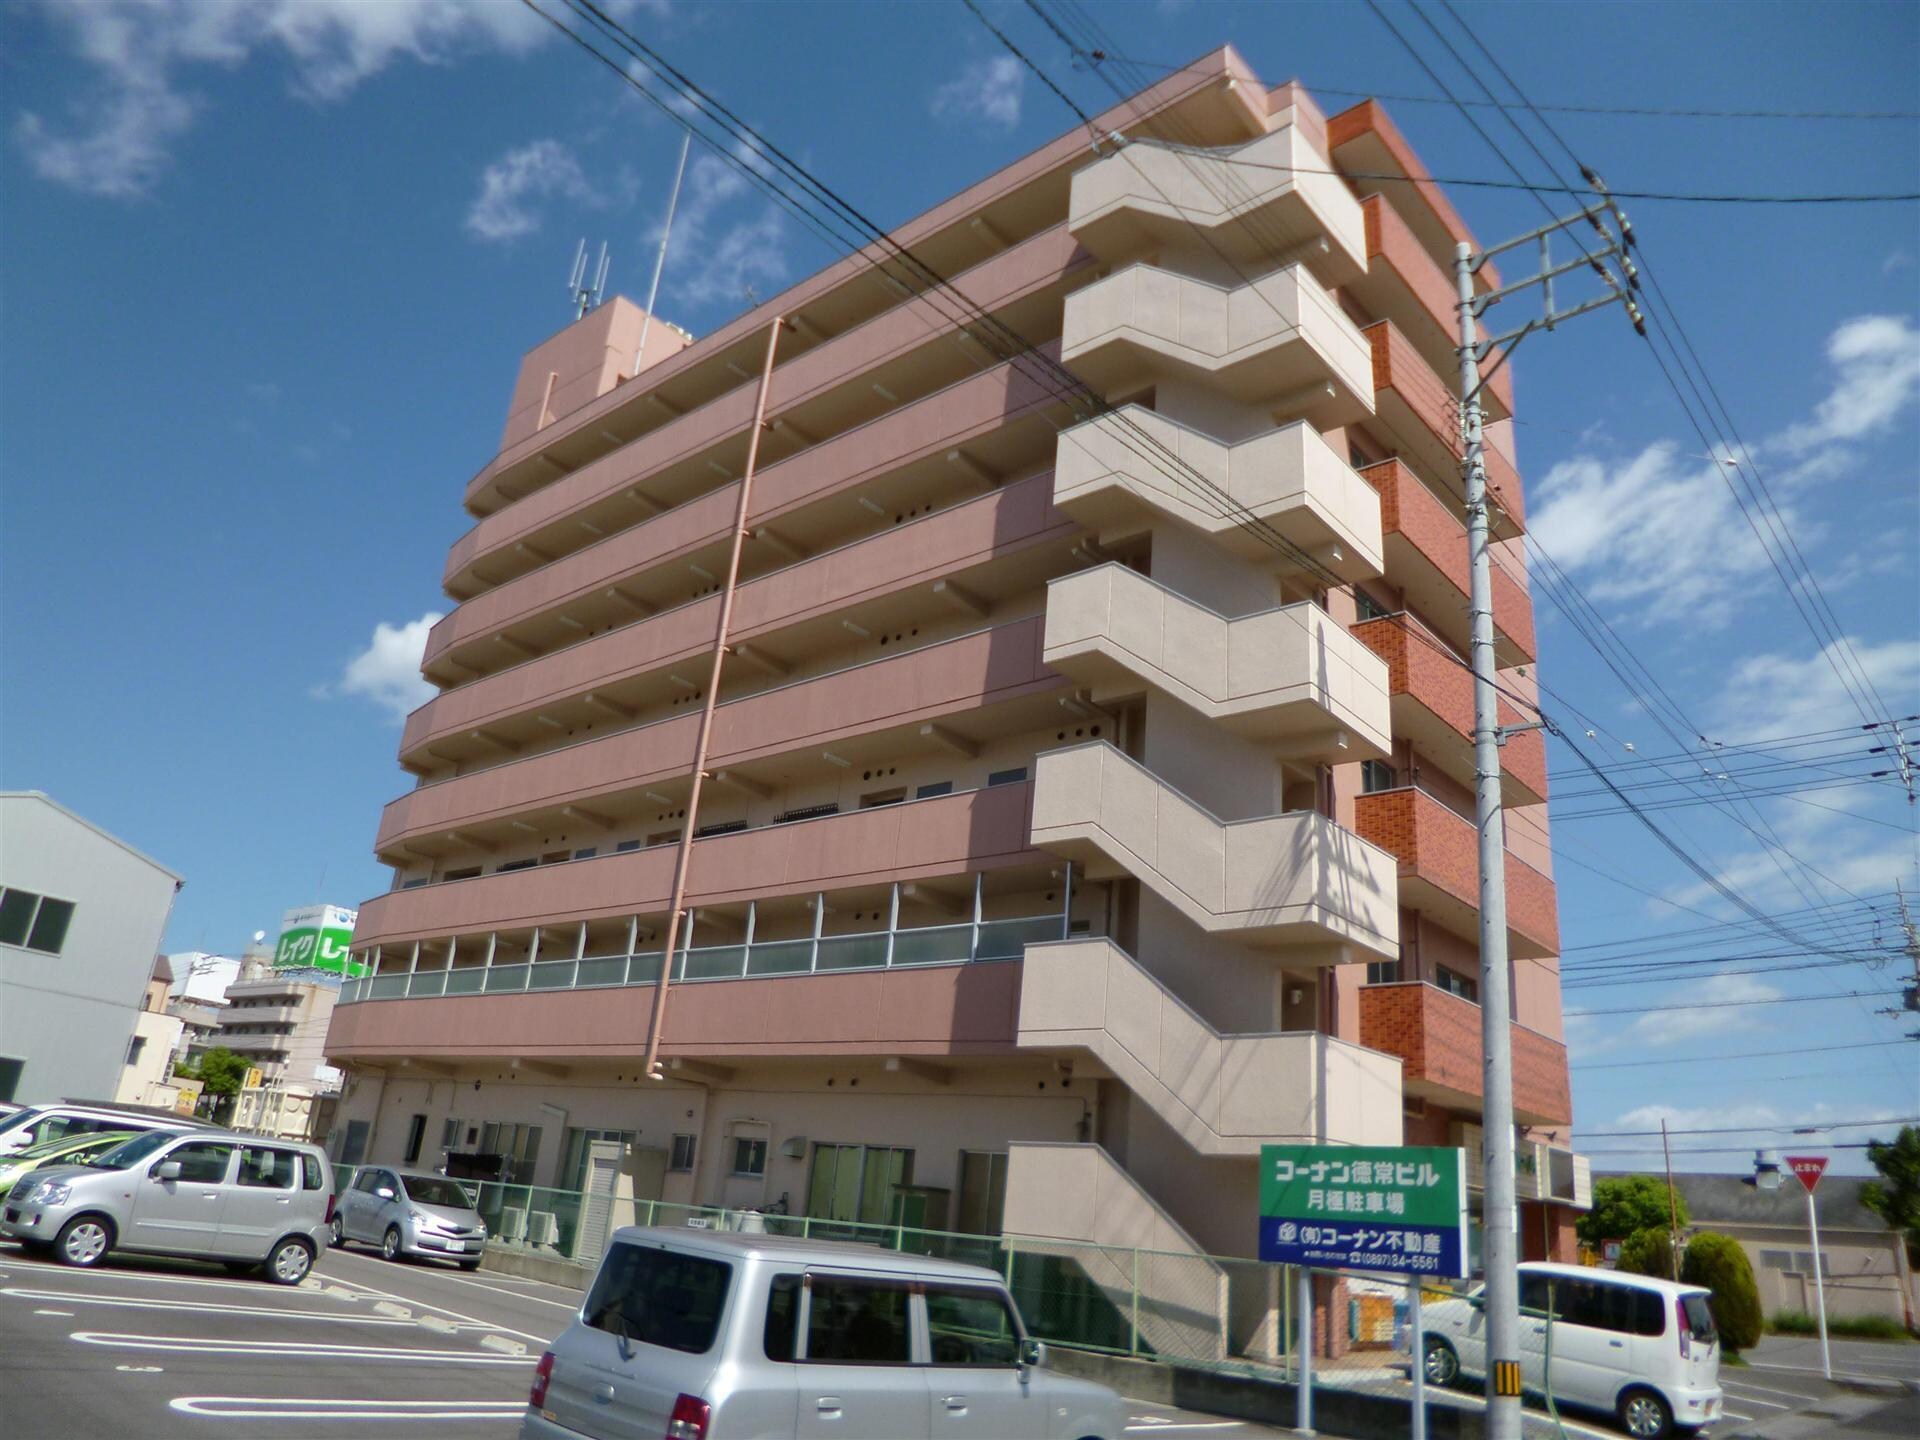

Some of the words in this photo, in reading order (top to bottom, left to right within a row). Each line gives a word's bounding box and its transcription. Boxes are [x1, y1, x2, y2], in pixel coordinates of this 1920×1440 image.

[278, 934, 315, 963] レイク
[1275, 1160, 1441, 1188] コーナン徳常ビル
[1794, 1163, 1821, 1173] 止まれ
[1307, 1189, 1405, 1215] 月極駐車場
